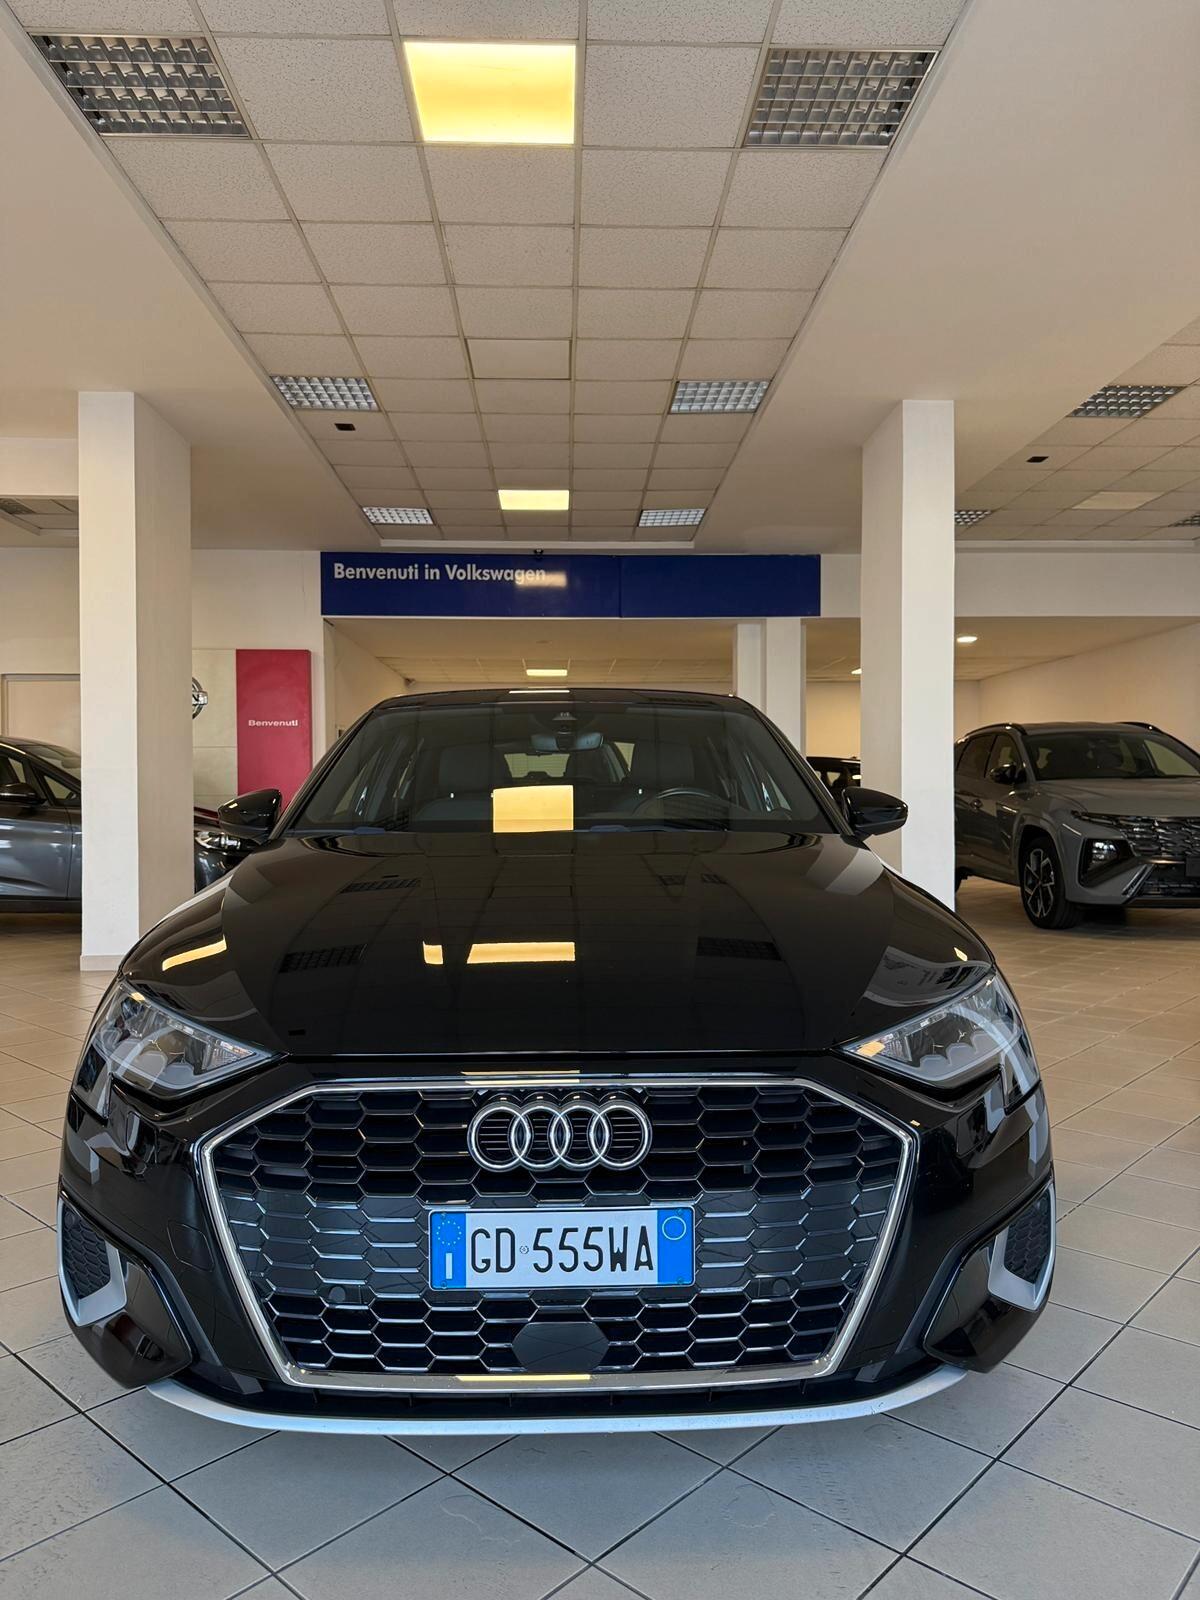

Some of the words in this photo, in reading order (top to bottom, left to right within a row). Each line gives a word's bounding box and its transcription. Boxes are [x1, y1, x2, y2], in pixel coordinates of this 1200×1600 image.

[333, 562, 420, 580] Benvenuti
[424, 563, 441, 580] in
[445, 563, 546, 585] Volkswagen
[248, 719, 298, 727] Benvenuti
[470, 1227, 516, 1273] GD
[532, 1225, 654, 1273] 555WA
